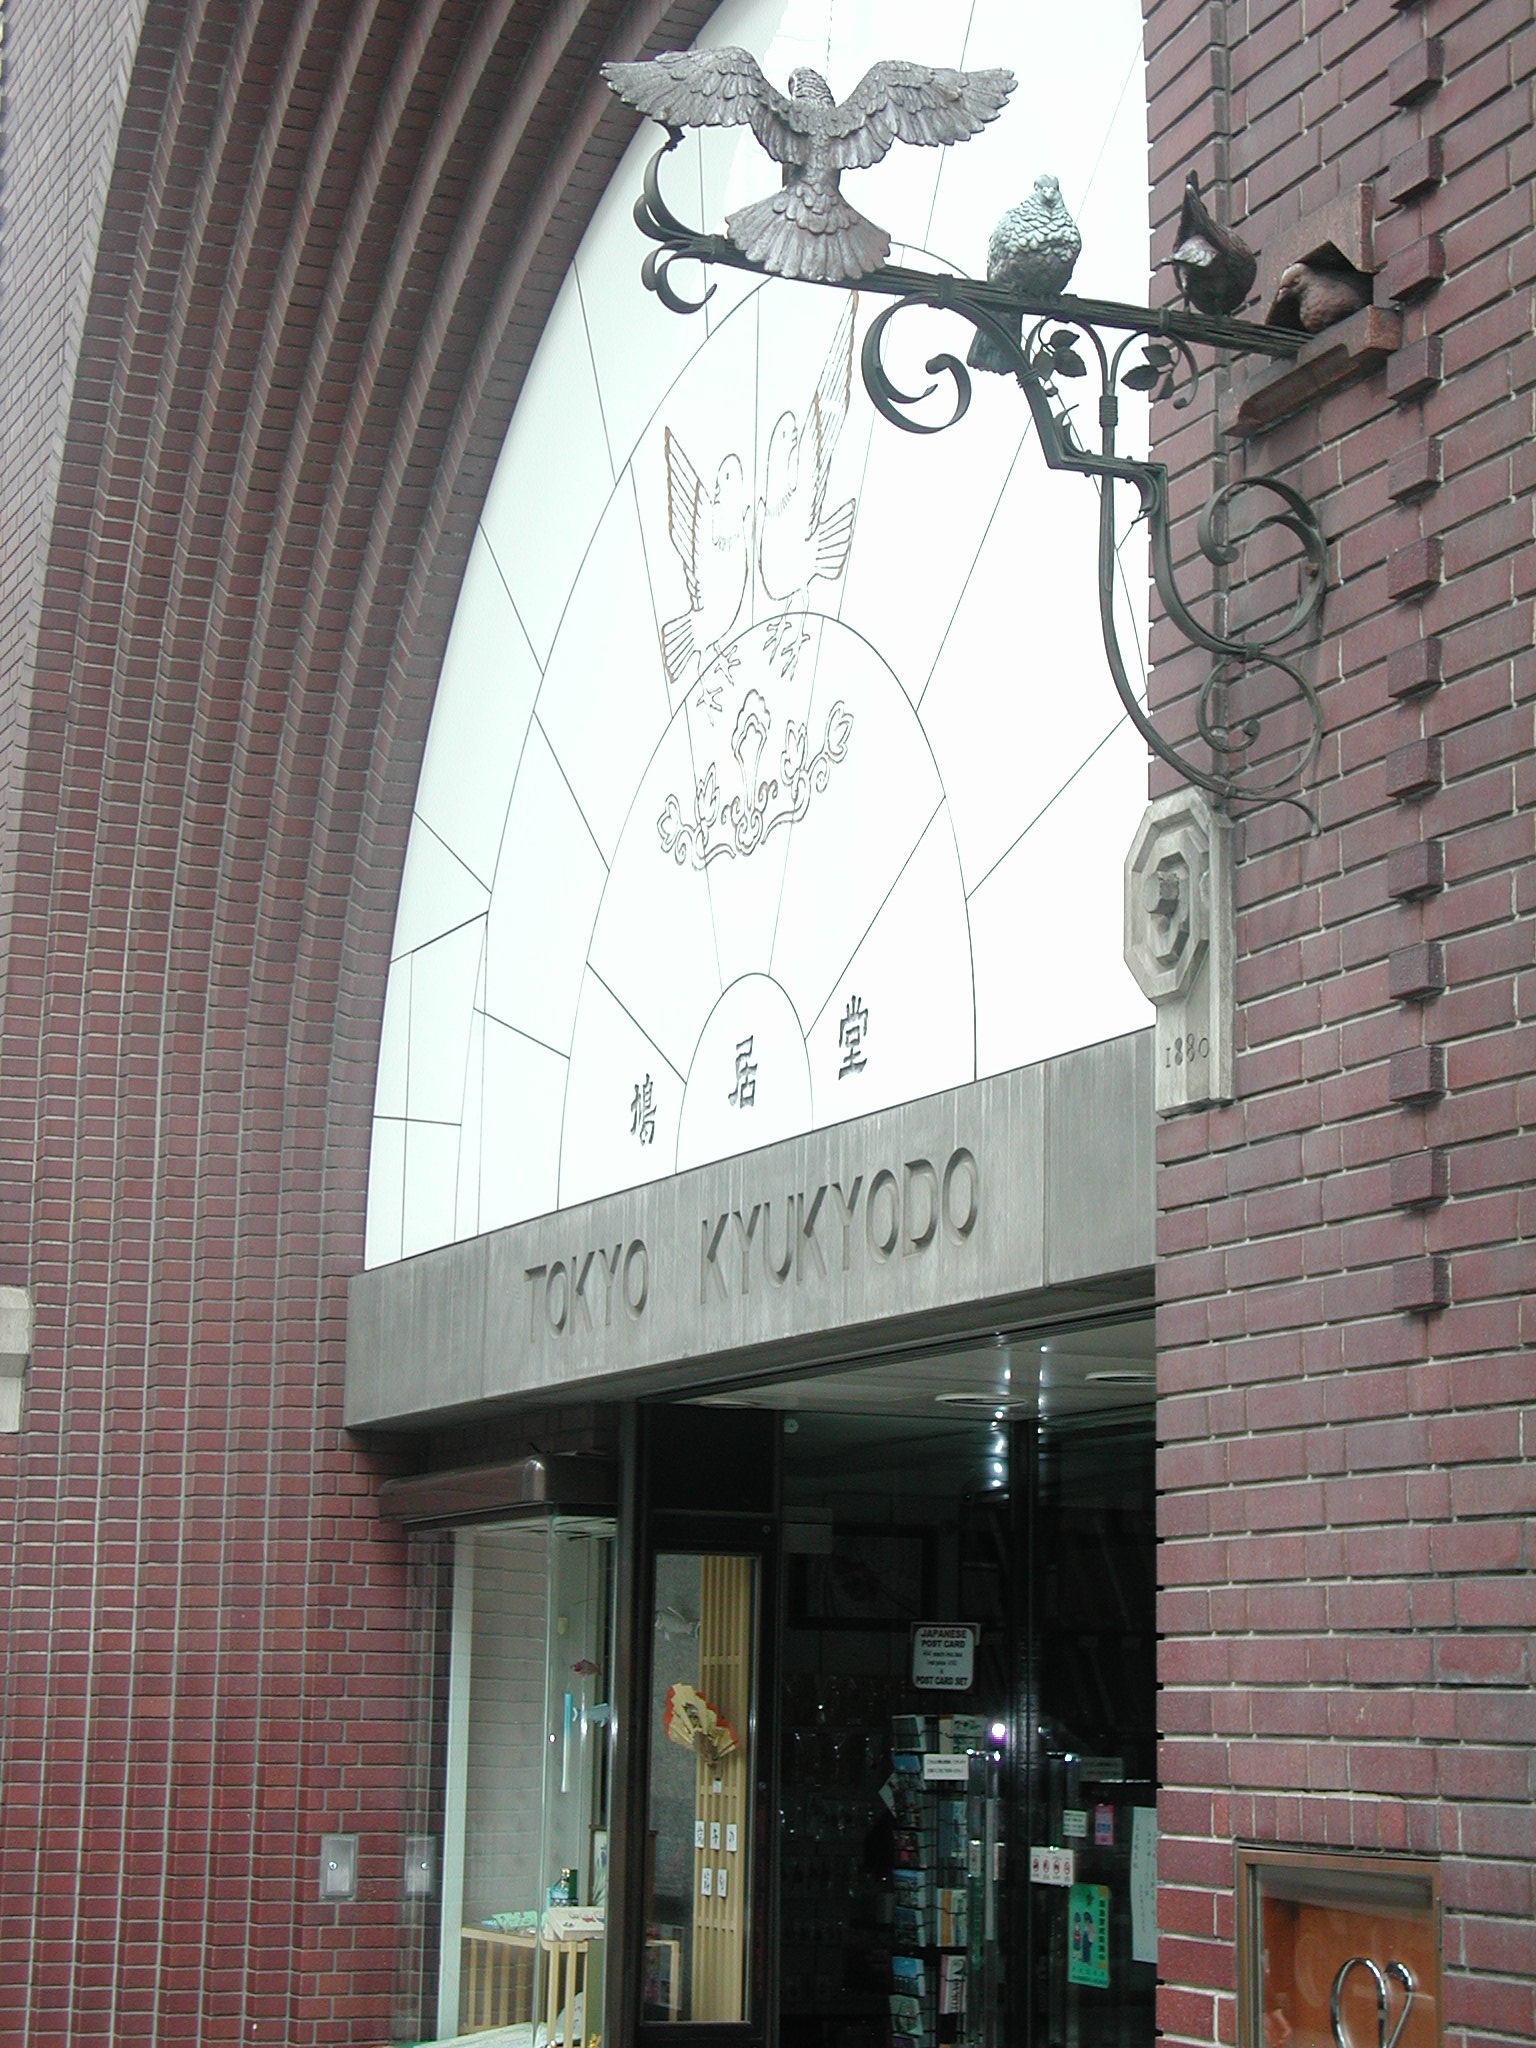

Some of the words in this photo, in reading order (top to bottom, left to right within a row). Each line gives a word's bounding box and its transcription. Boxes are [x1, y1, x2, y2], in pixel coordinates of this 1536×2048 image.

[1164, 1033, 1210, 1068] 1880
[524, 1238, 649, 1343] TOKYO
[700, 1147, 979, 1305] KYUKYODO
[920, 1629, 967, 1638] JAPANESE
[921, 1639, 942, 1648] POST
[944, 1640, 966, 1649] CARD
[916, 1676, 933, 1685] POST
[935, 1676, 954, 1685] CARD
[954, 1677, 968, 1686] SET
